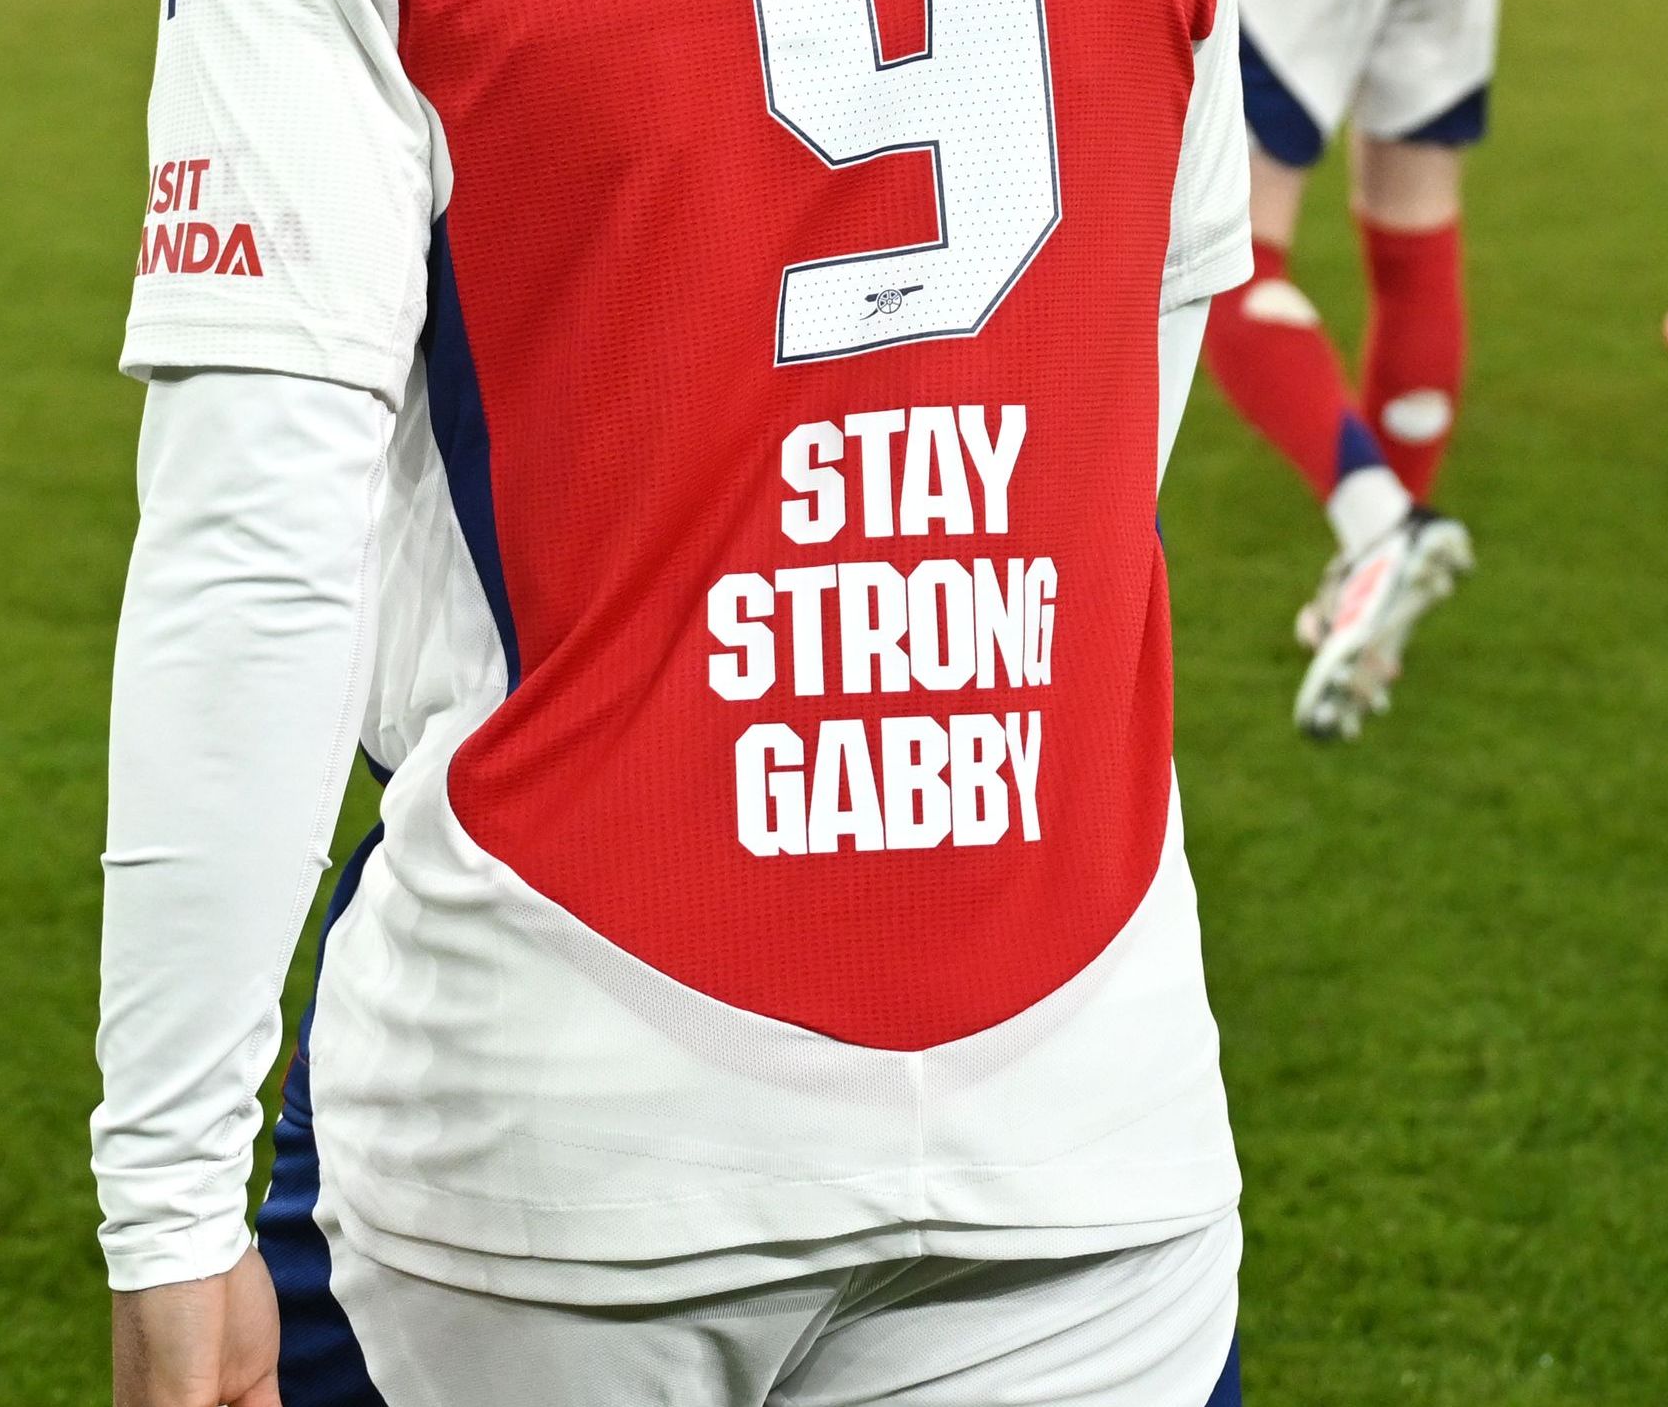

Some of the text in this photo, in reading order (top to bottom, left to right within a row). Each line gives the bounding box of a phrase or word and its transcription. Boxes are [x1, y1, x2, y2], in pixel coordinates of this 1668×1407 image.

[136, 222, 264, 277] ANDA
[147, 158, 211, 215] ISIT
[780, 404, 1027, 545] STAY
[707, 556, 1058, 702] STRONG
[734, 710, 1042, 857] GABBY
